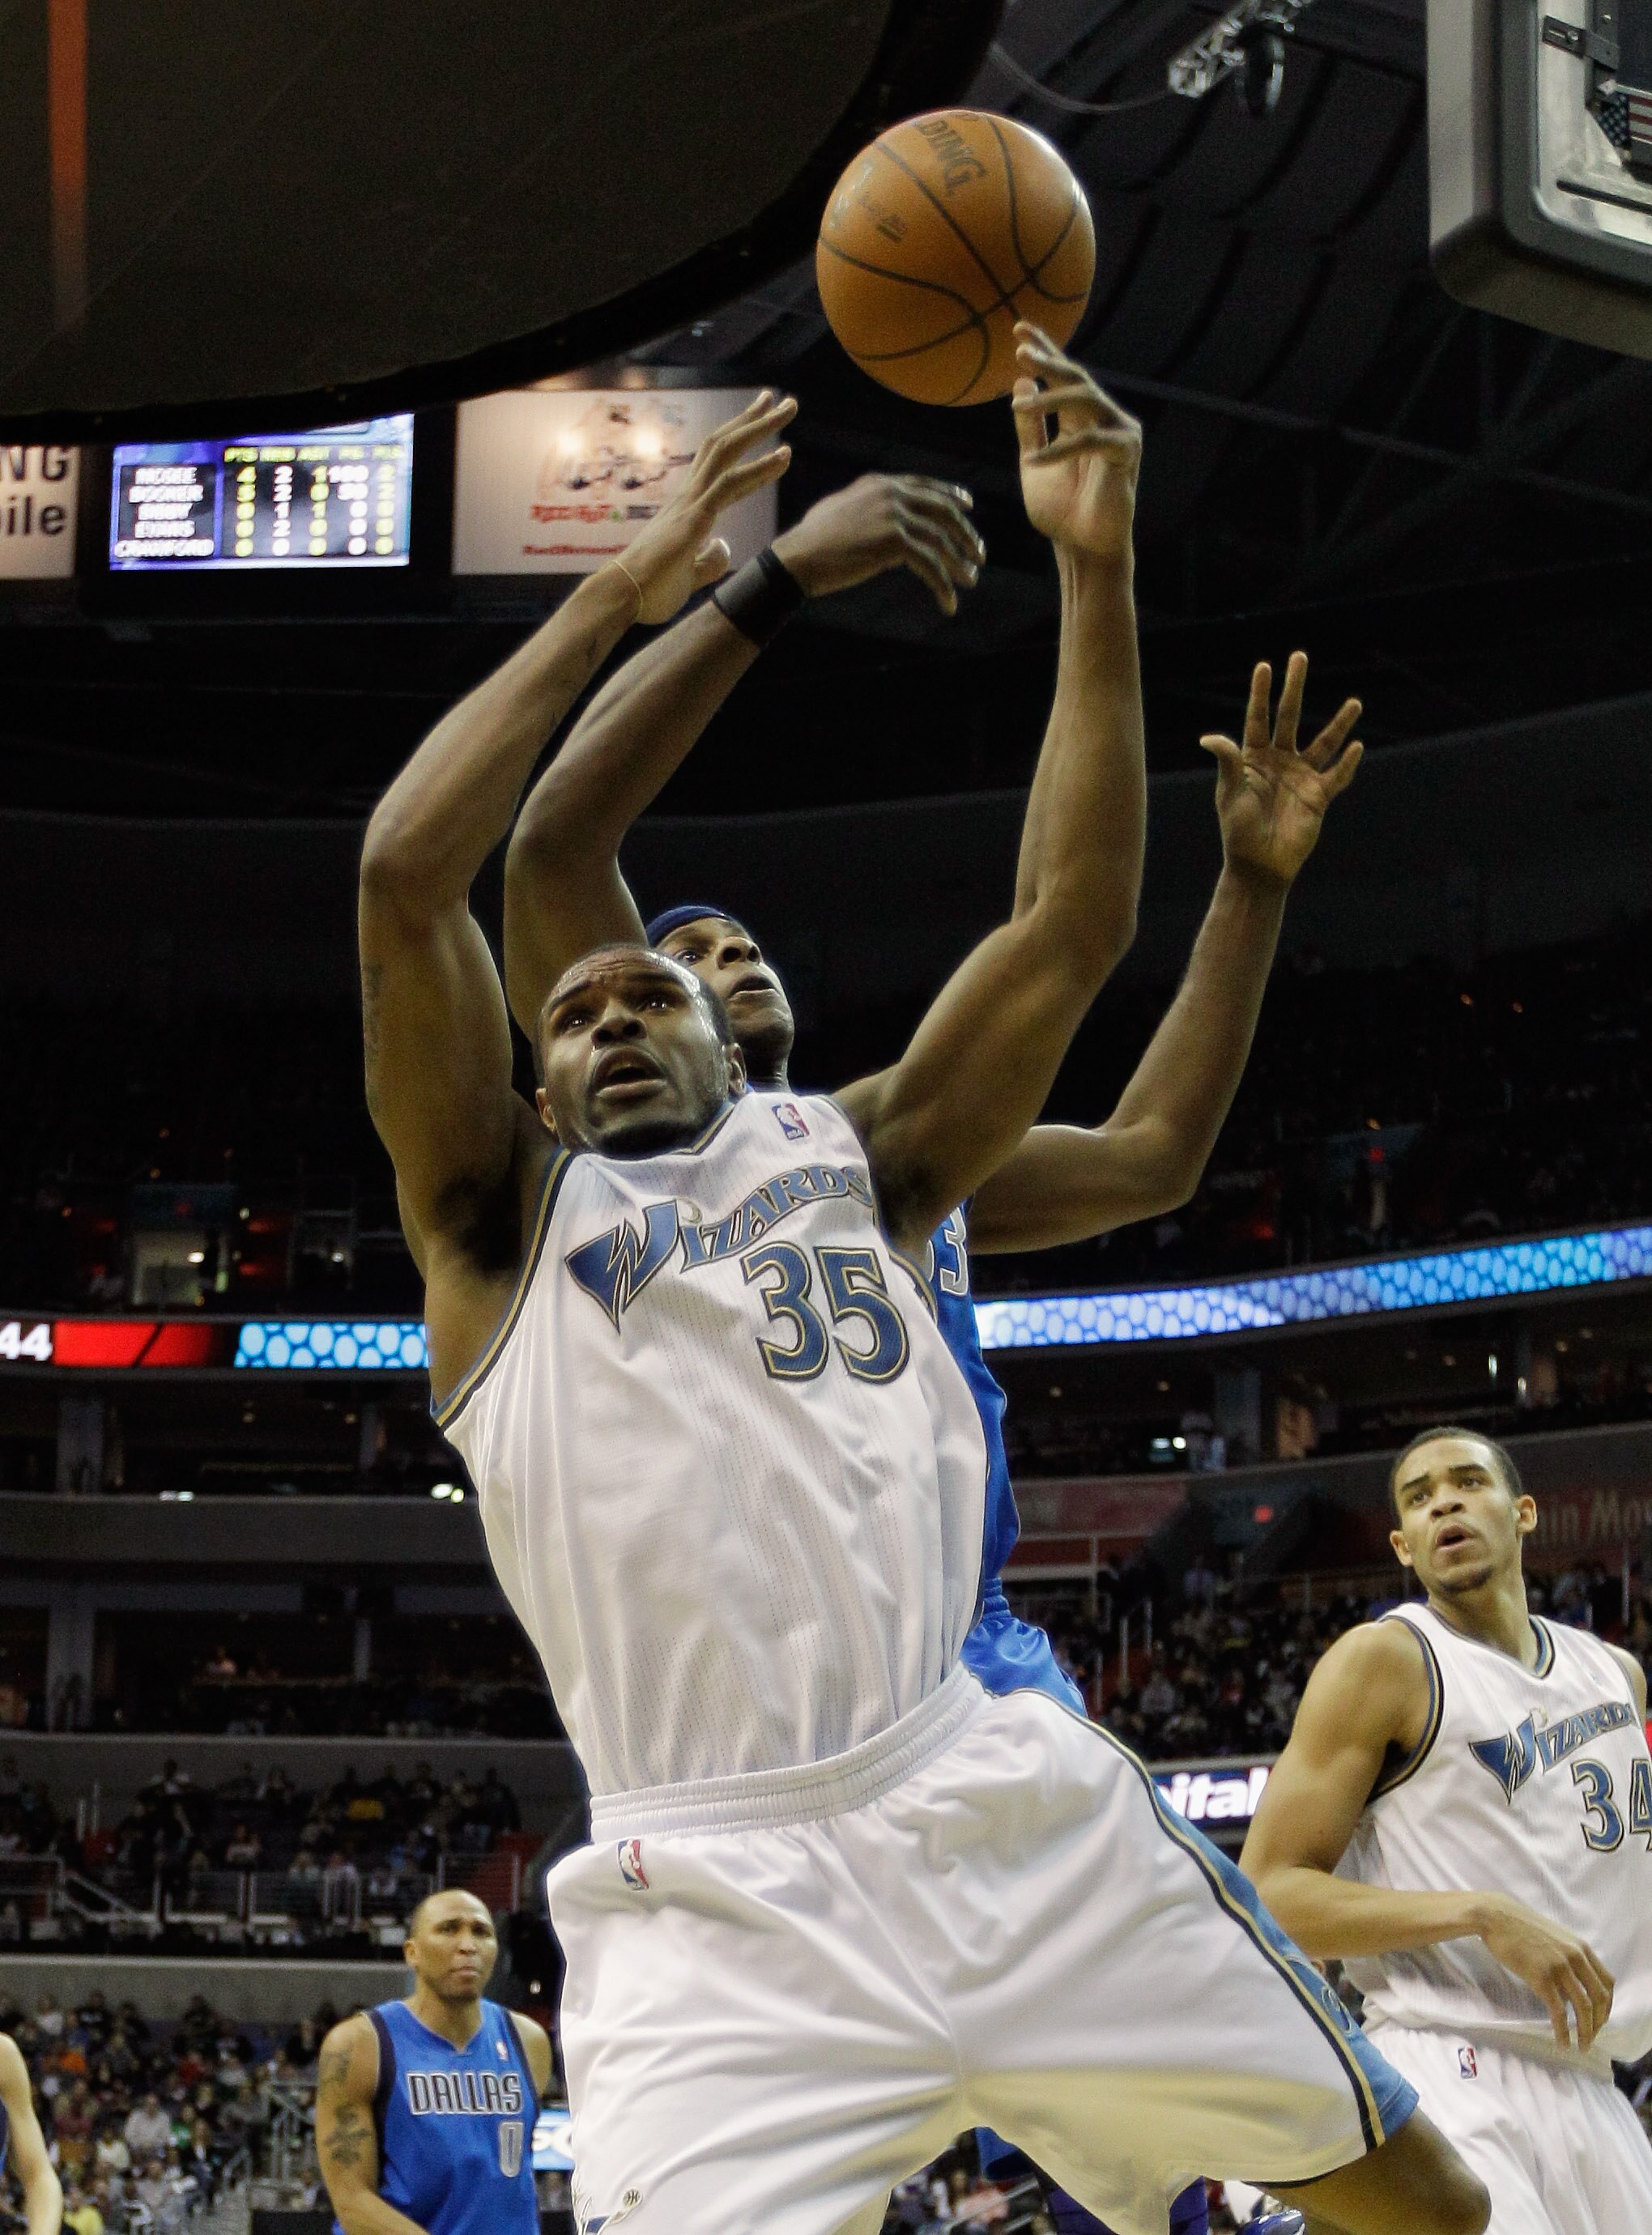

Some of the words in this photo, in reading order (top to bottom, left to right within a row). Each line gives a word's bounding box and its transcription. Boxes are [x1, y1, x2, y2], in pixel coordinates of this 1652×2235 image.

[237, 466, 256, 483] 4
[275, 466, 292, 483] 2
[312, 465, 327, 483] 1
[274, 484, 292, 501] 2
[7, 495, 66, 535] ile
[275, 502, 290, 519] 1
[312, 501, 326, 519] 1
[273, 519, 291, 537] 2
[740, 1241, 910, 1384] 35
[407, 2072, 522, 2116] DALLAS
[498, 2120, 524, 2178] 0
